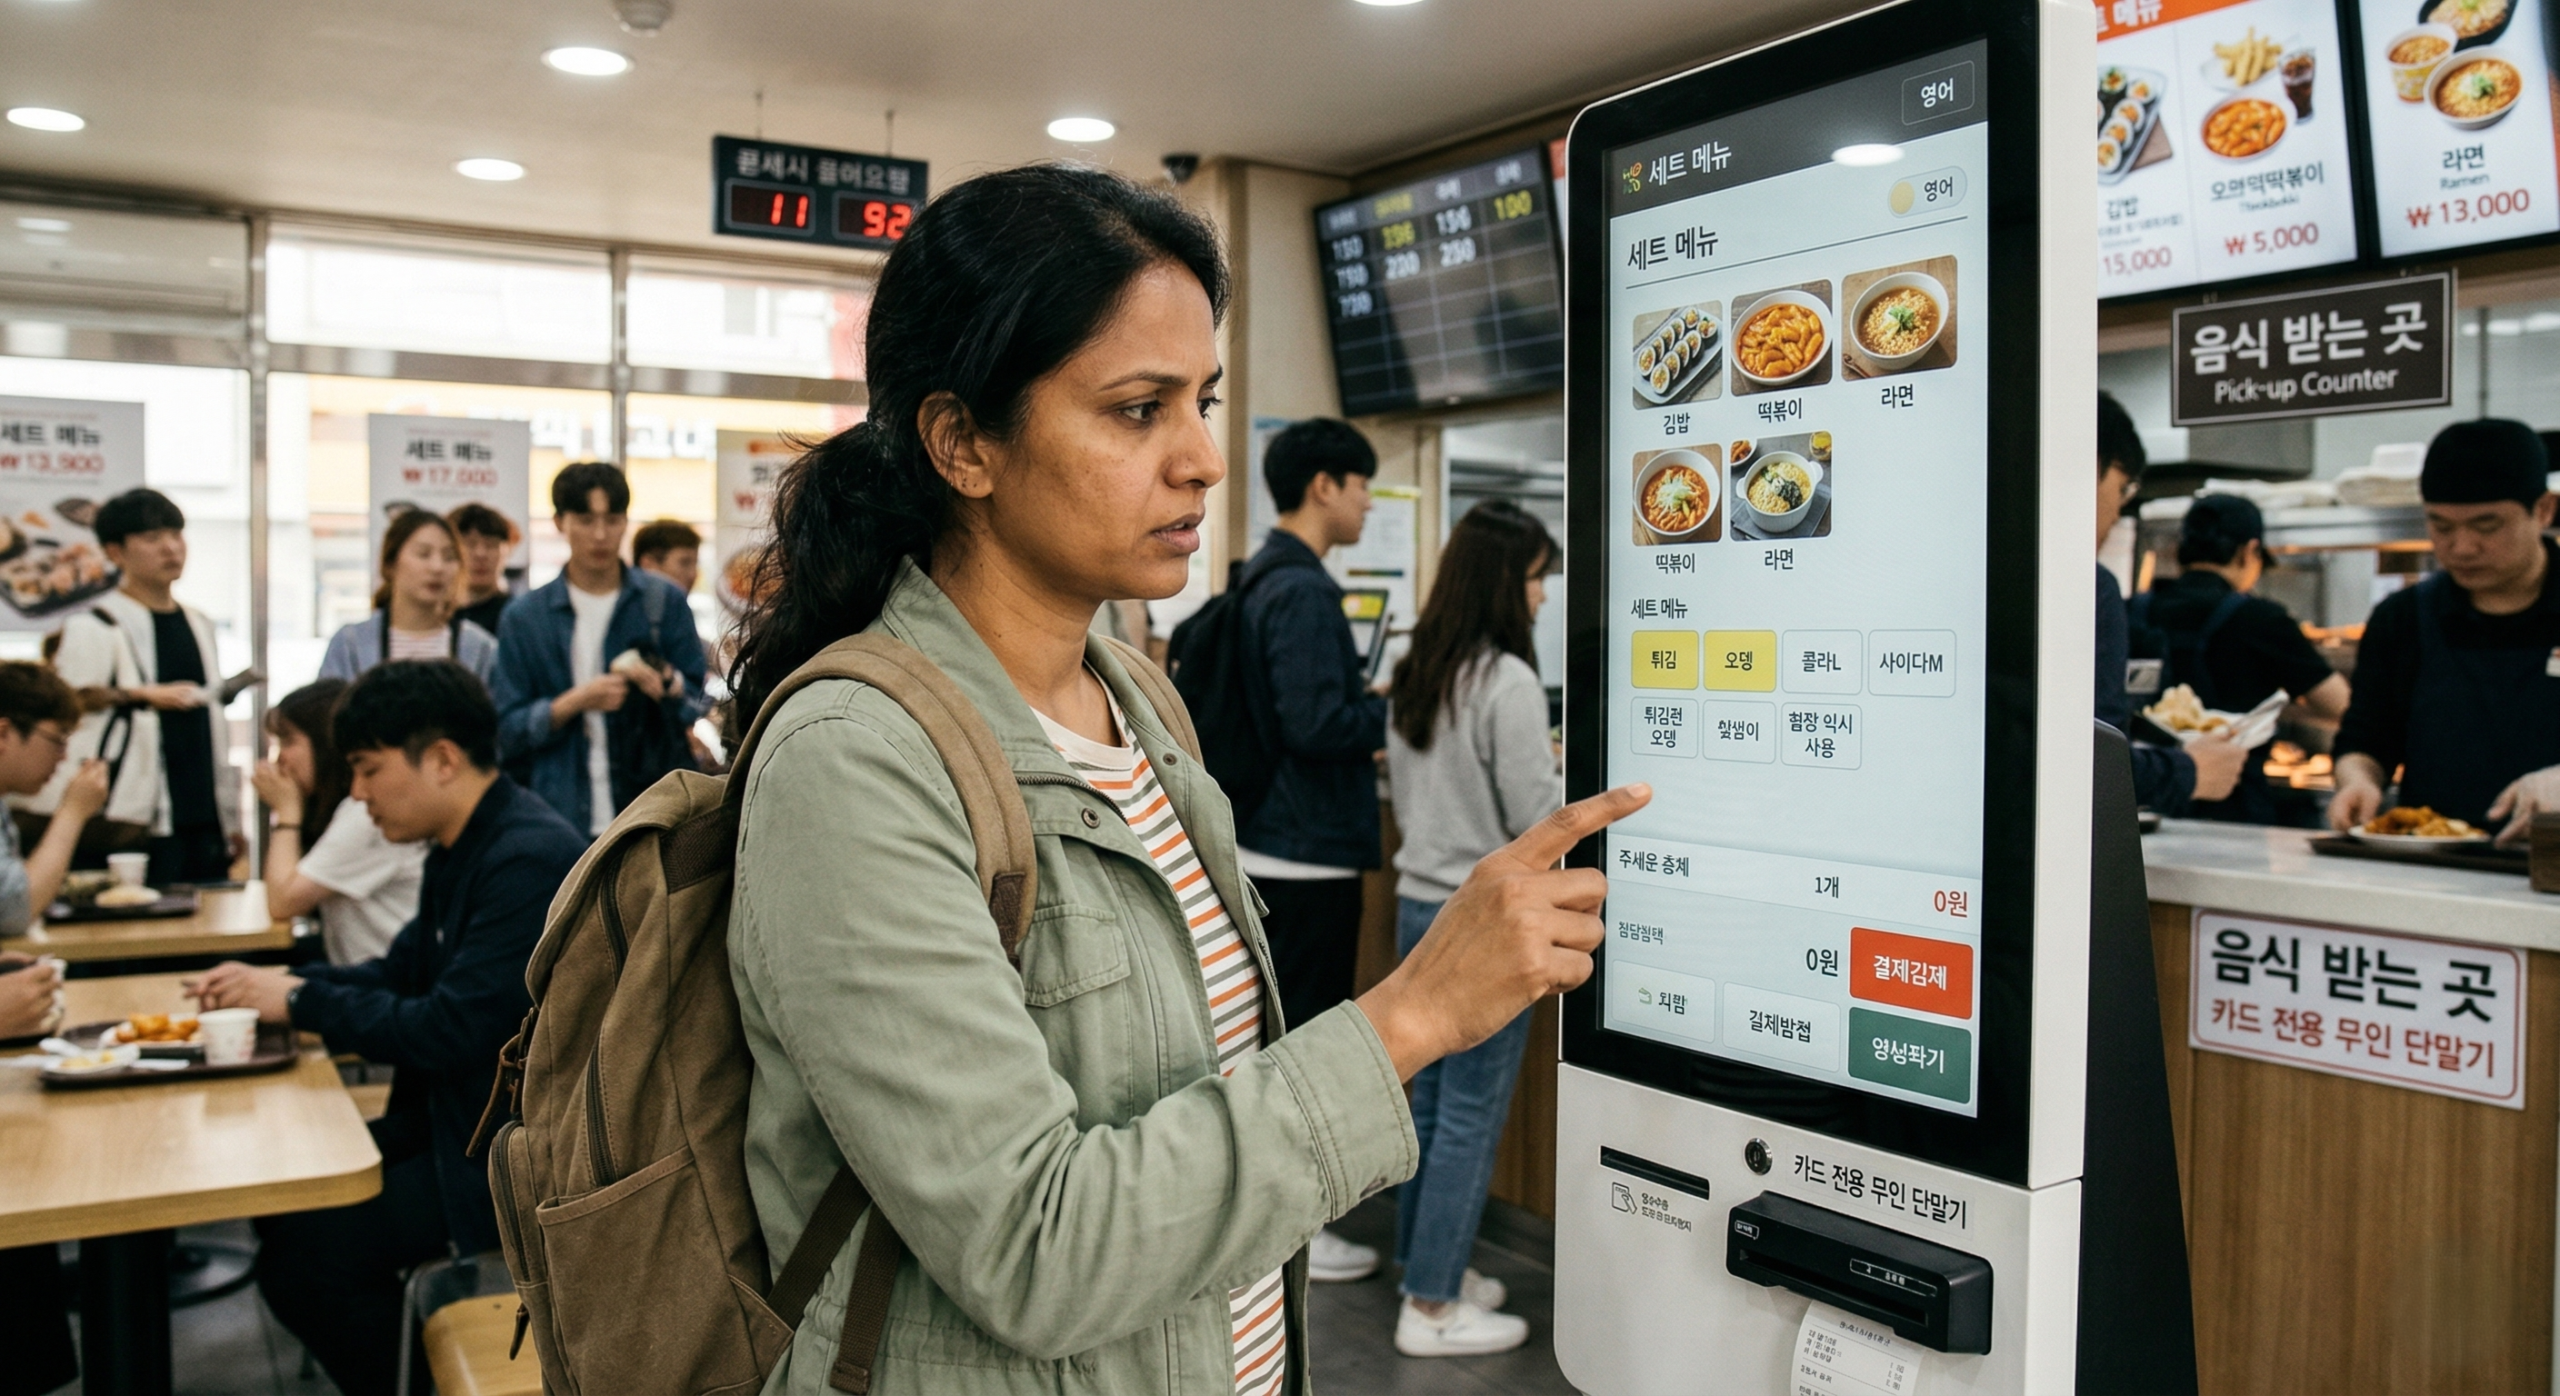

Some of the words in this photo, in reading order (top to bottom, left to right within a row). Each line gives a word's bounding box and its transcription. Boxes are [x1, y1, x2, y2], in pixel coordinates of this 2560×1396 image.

[1921, 78, 1954, 108] 영어
[1649, 152, 1688, 186] 세트
[1692, 141, 1732, 173] 메뉴
[2443, 143, 2484, 171] 라면
[1924, 176, 1954, 202] 영어
[2440, 174, 2489, 190] Ramen
[771, 193, 808, 227] 11
[2440, 188, 2529, 223] 13,000
[863, 201, 912, 240] 92
[1627, 236, 1668, 271] 세트
[1675, 226, 1719, 259] 메뉴
[2254, 222, 2318, 253] 5,000
[2103, 246, 2171, 276] 15,000
[2190, 319, 2268, 375] 음식
[2283, 311, 2369, 364] 받는
[2380, 302, 2427, 354] 곳
[1881, 384, 1914, 409] 라면
[2215, 377, 2297, 404] Pick-up
[2302, 369, 2398, 396] Counter
[1663, 412, 1691, 435] 김밥
[1758, 398, 1802, 423] 떡볶이
[1656, 553, 1695, 574] 떡볶이
[1764, 549, 1794, 571] 라면
[1631, 599, 1658, 620] 세트
[1661, 598, 1688, 620] 메뉴
[1651, 650, 1677, 669] 튀김
[1725, 651, 1753, 671] 오뎅
[1801, 651, 1842, 673] 콜라L
[1879, 652, 1943, 674] 사이다M
[1823, 713, 1852, 735] 익시
[1651, 730, 1676, 748] 오뎅
[1805, 737, 1835, 759] 사용
[1814, 876, 1840, 899] 1개
[1933, 890, 1968, 918] 0원
[1806, 948, 1839, 978] 0원
[1873, 955, 1947, 990] 결제김제
[2211, 929, 2299, 994] 음식
[2323, 943, 2422, 1011] 받는
[2442, 960, 2497, 1023] 곳
[2211, 998, 2262, 1034] 카드
[2273, 1007, 2325, 1048] 전용
[2336, 1019, 2391, 1059] 무인
[2404, 1029, 2494, 1078] 단말기
[1794, 1155, 1826, 1184] 카드
[1832, 1165, 1865, 1198] 전용
[1871, 1176, 1905, 1211] 무인
[1912, 1187, 1966, 1230] 단말기
